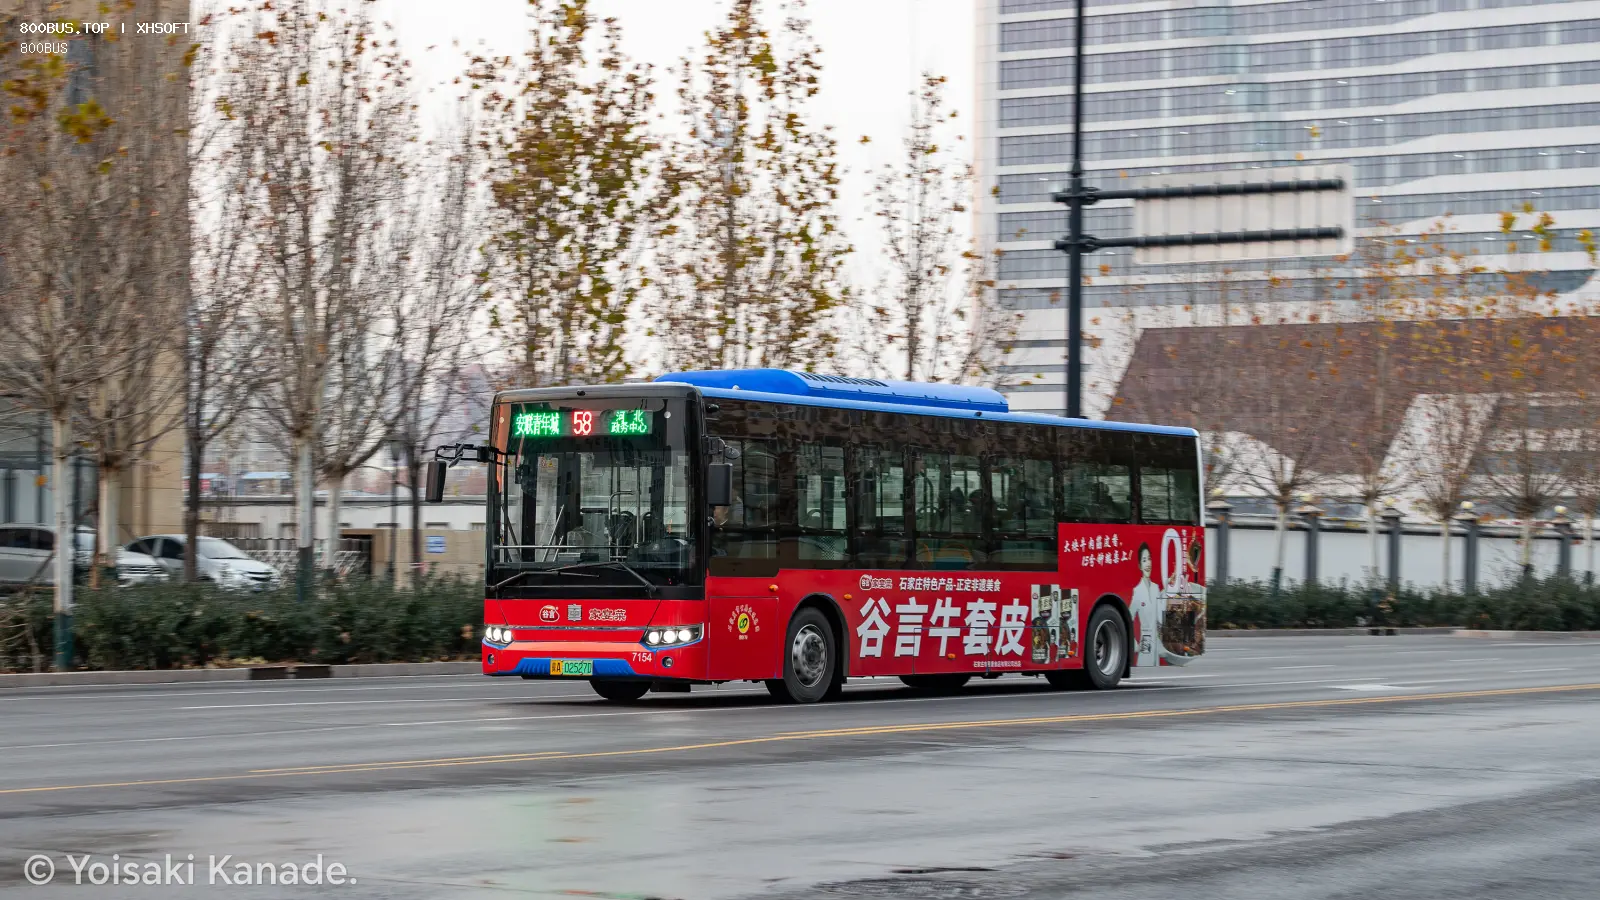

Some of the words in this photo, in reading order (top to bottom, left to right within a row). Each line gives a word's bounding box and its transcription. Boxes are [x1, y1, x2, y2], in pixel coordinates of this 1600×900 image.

[515, 412, 560, 436] 安联青年城
[573, 410, 592, 436] 58
[610, 421, 648, 434] 政务中心
[856, 596, 1029, 658] 谷言牛套皮
[632, 652, 652, 663] 7154
